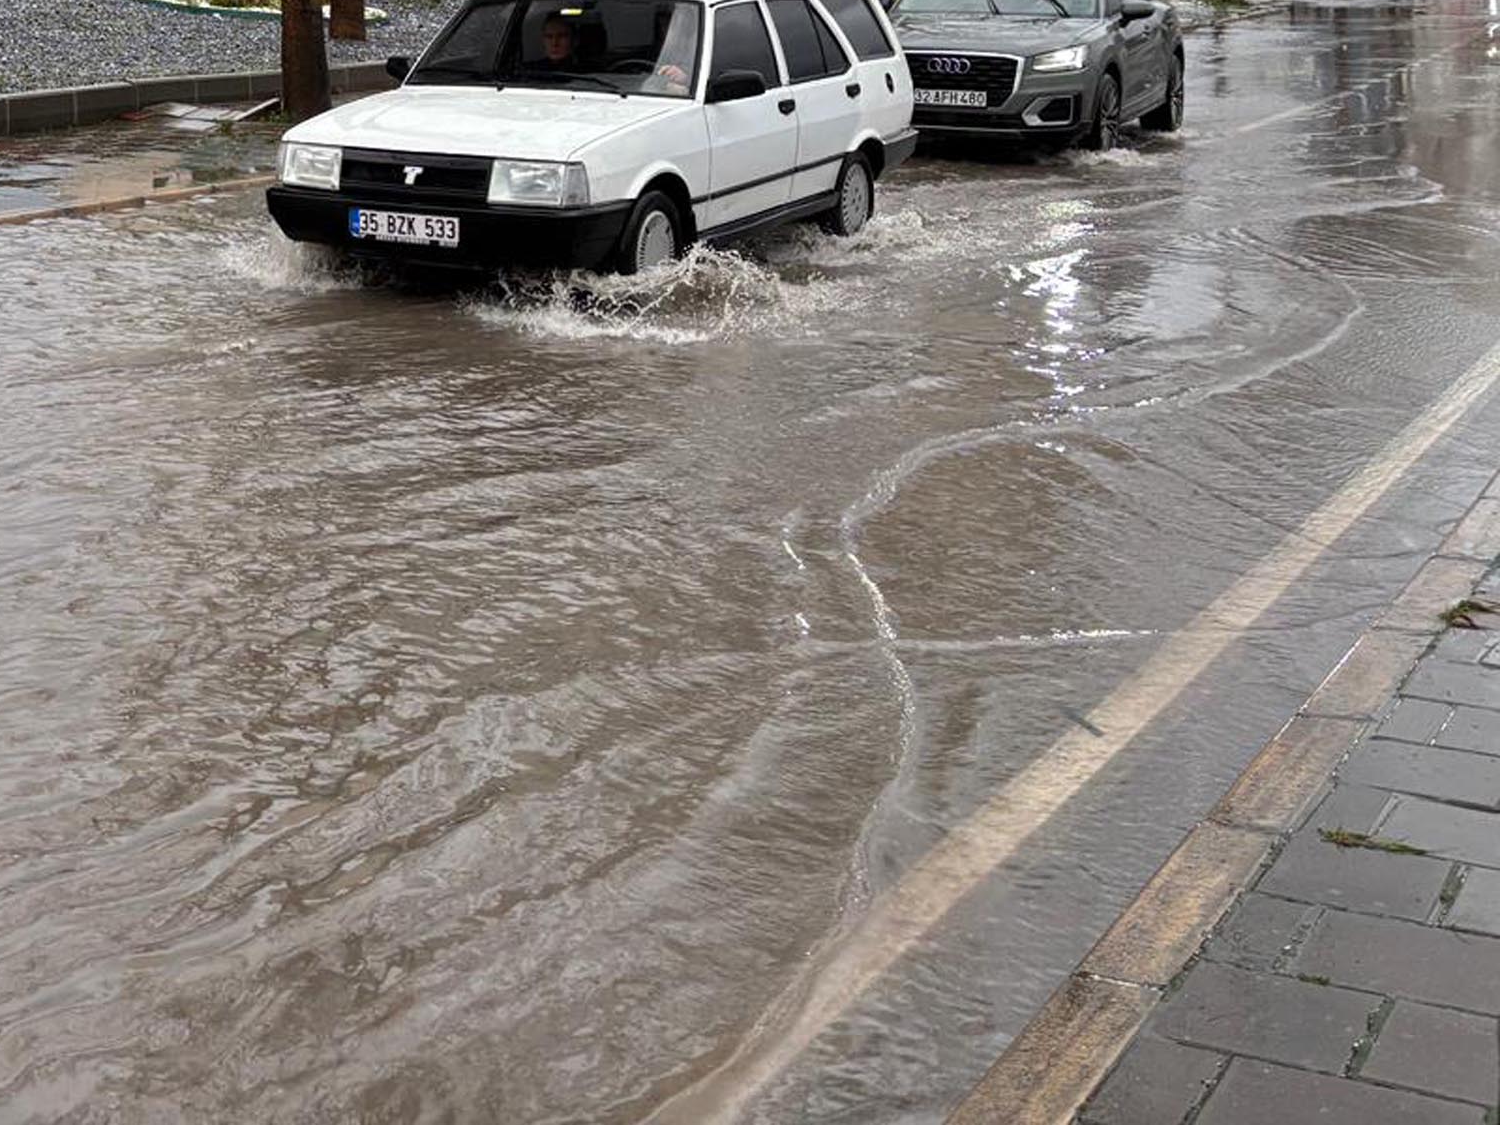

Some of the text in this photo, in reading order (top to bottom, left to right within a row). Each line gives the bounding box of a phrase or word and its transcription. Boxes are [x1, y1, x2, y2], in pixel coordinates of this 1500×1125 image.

[360, 212, 379, 233] 35
[387, 215, 416, 236] BZK
[425, 218, 456, 240] 533
